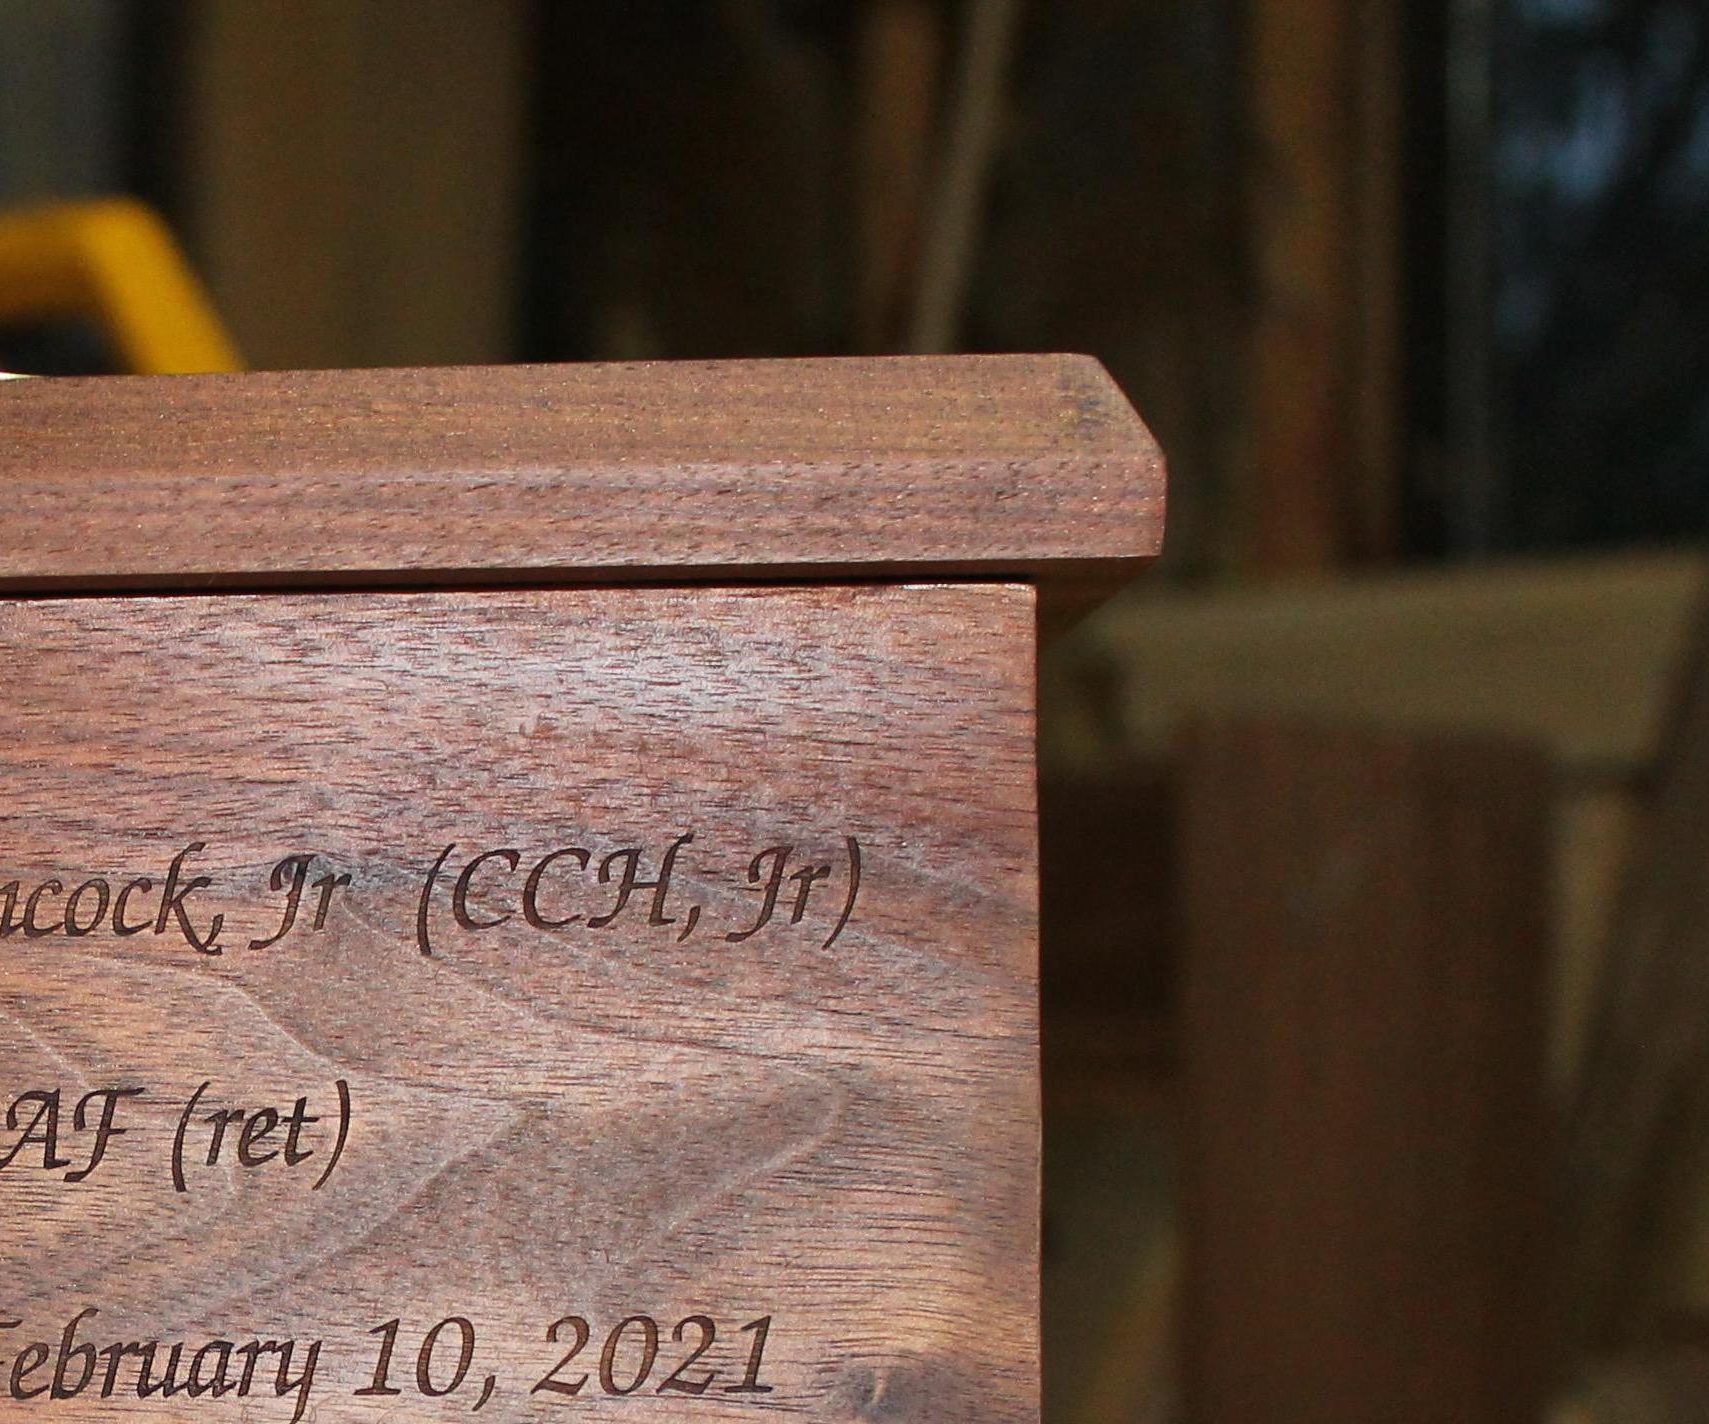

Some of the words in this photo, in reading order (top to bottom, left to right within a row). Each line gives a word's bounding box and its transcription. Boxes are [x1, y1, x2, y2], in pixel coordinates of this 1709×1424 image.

[249, 853, 351, 950] Jr
[417, 834, 699, 956] (CCH,
[725, 836, 860, 951] Jr)
[171, 1080, 351, 1193] (ret)
[354, 1315, 498, 1412] 10,
[534, 1314, 774, 1395] 2021
